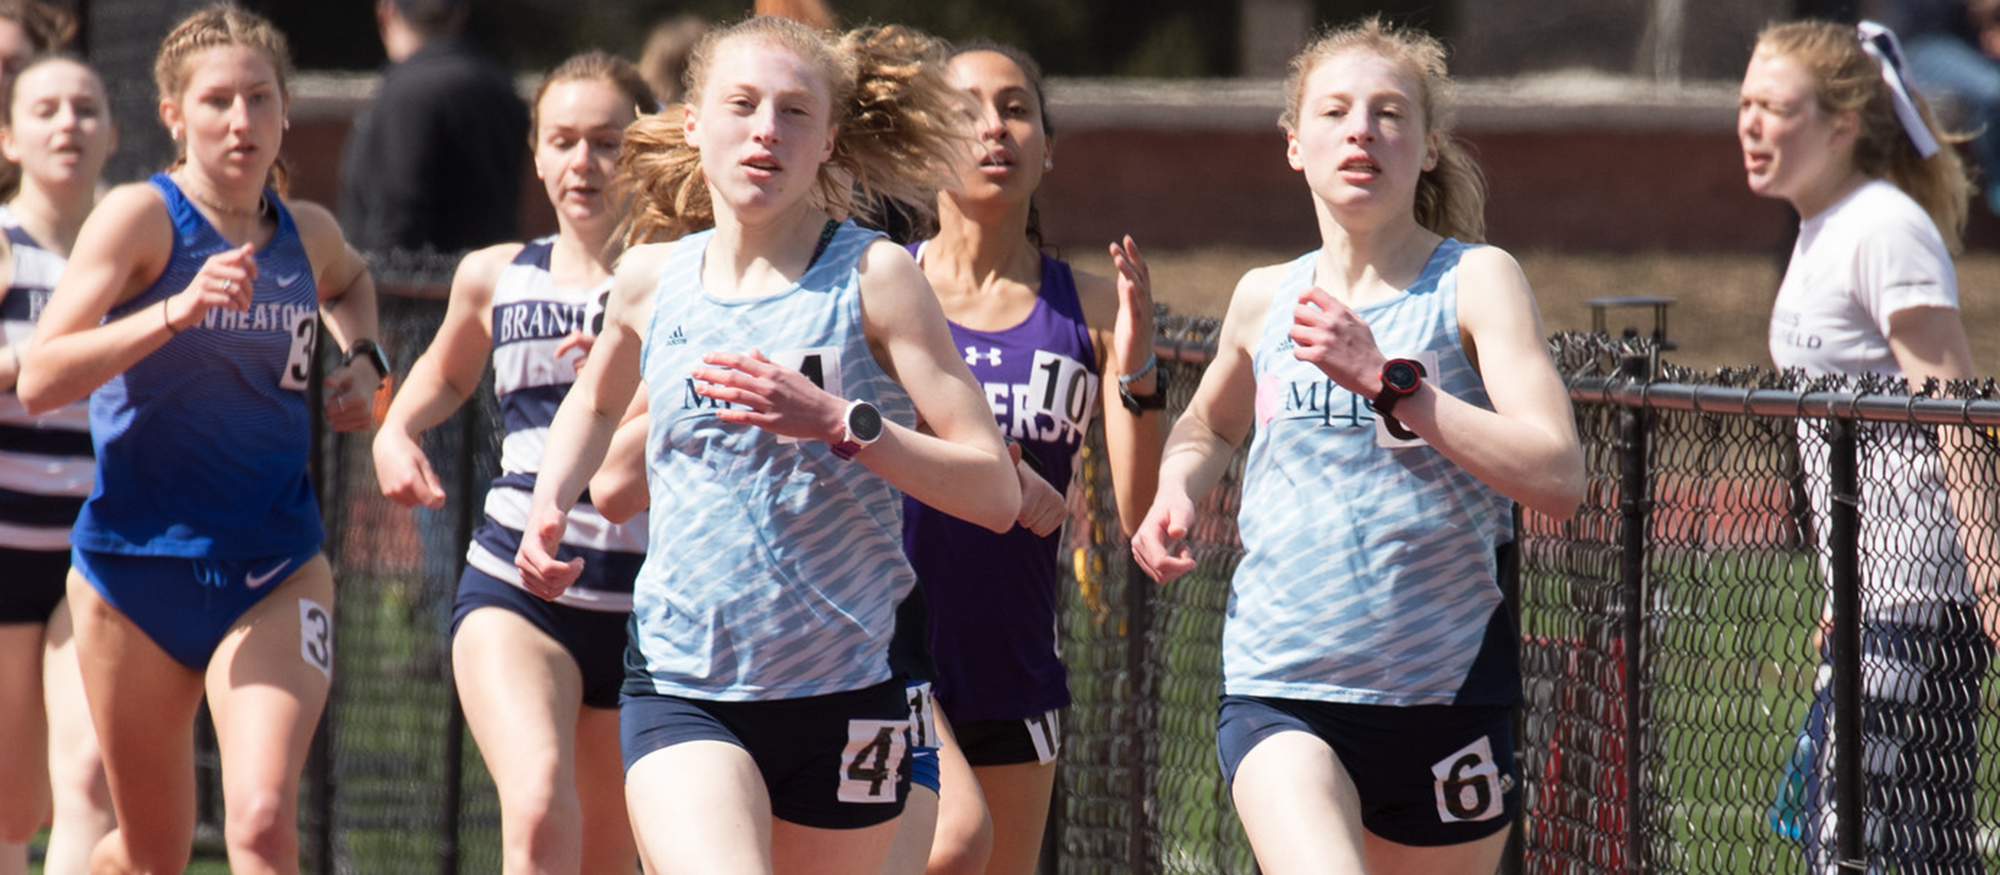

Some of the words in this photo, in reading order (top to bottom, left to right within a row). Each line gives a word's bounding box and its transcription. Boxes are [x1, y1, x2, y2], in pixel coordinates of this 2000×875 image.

[291, 318, 315, 382] 3
[1040, 358, 1088, 424] 10
[307, 607, 329, 670] 3
[847, 727, 895, 796] 4
[1443, 753, 1491, 819] 6
